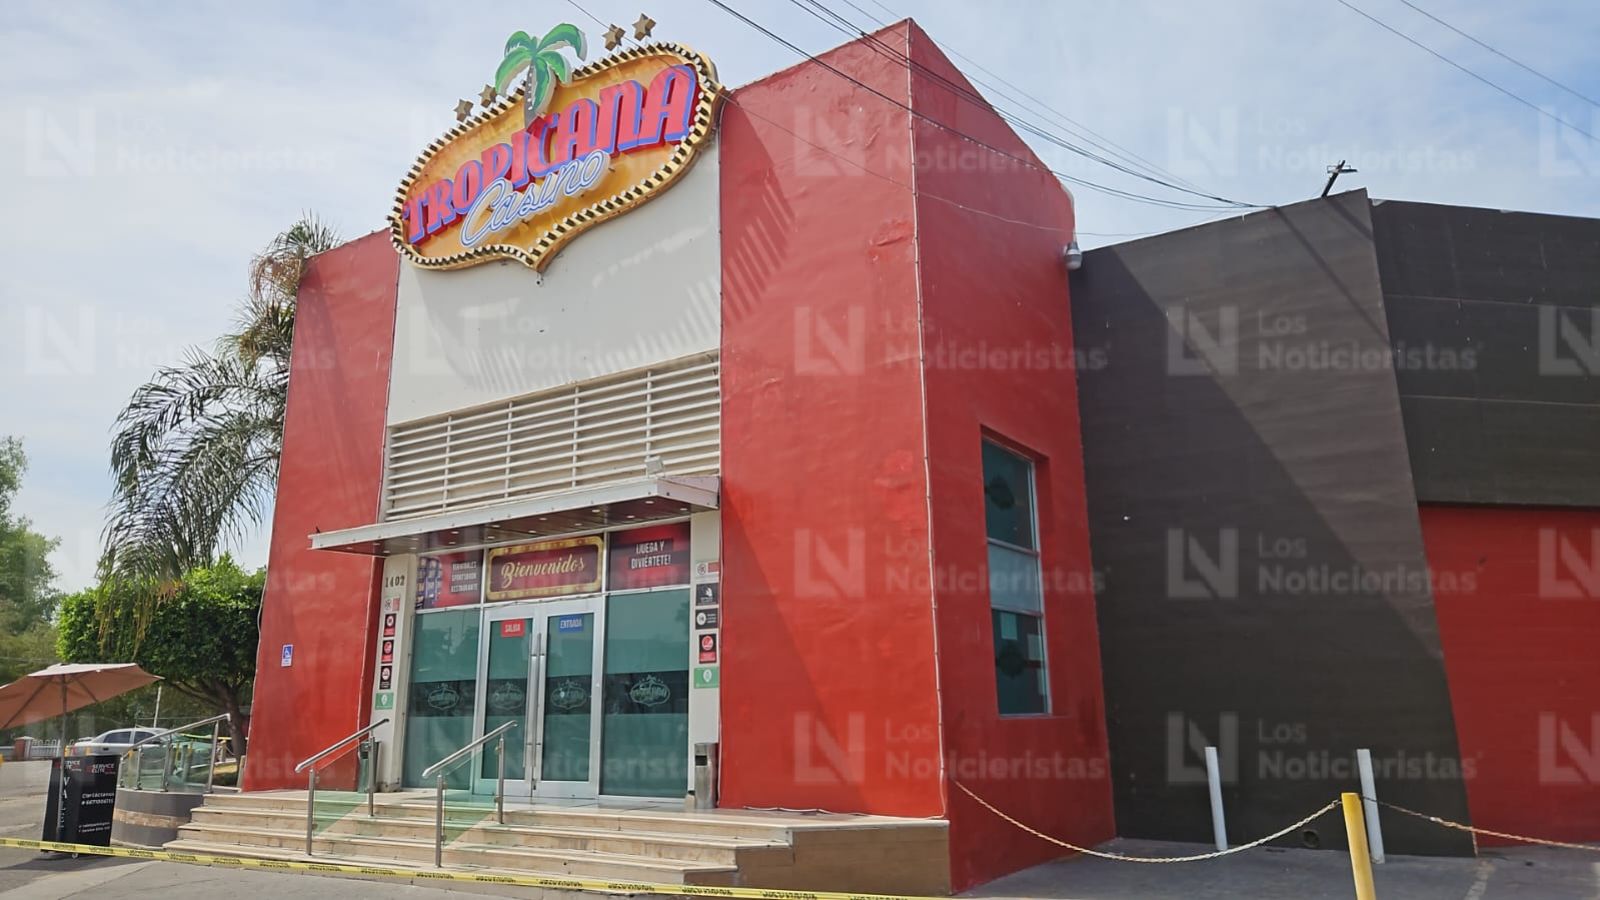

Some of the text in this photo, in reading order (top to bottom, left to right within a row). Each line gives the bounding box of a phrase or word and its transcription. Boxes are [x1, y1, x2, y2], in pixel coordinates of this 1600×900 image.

[403, 64, 699, 243] TROPICANA
[461, 150, 610, 248] Casino
[660, 541, 665, 552] Y
[501, 554, 585, 588] Bienvenidos
[560, 618, 582, 629] ENTRADA
